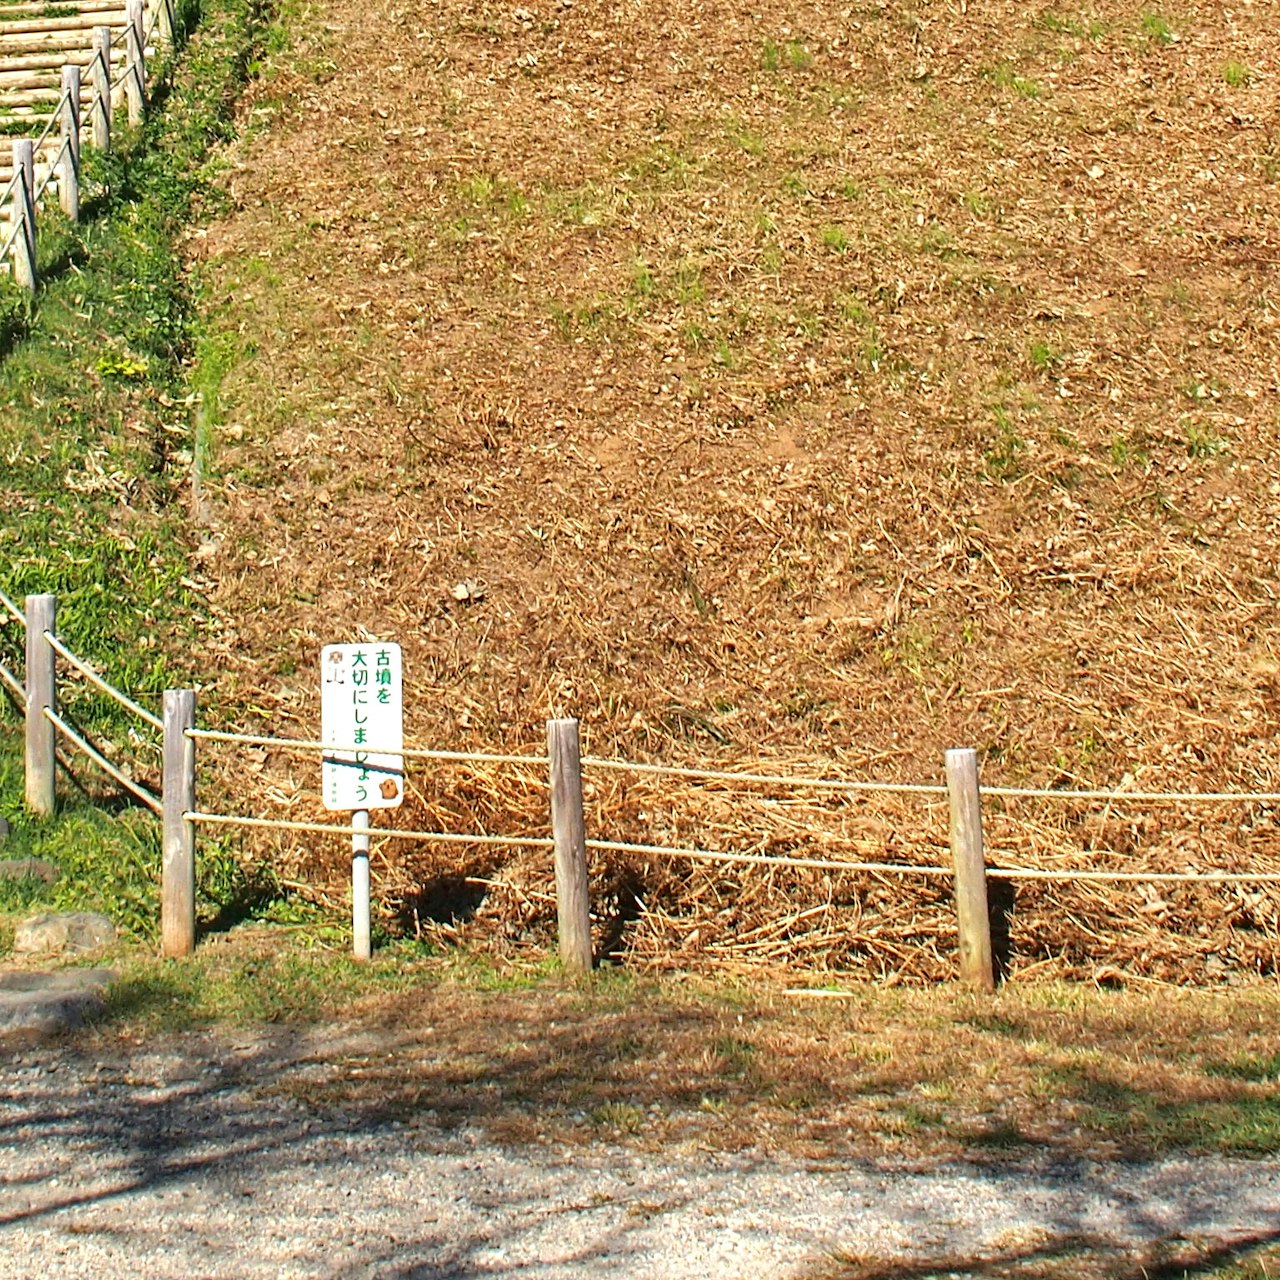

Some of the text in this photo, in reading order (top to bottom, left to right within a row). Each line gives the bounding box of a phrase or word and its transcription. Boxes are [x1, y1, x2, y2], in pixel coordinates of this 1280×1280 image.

[352, 650, 370, 802] 大切にしましょう
[375, 649, 392, 704] 古墳を
